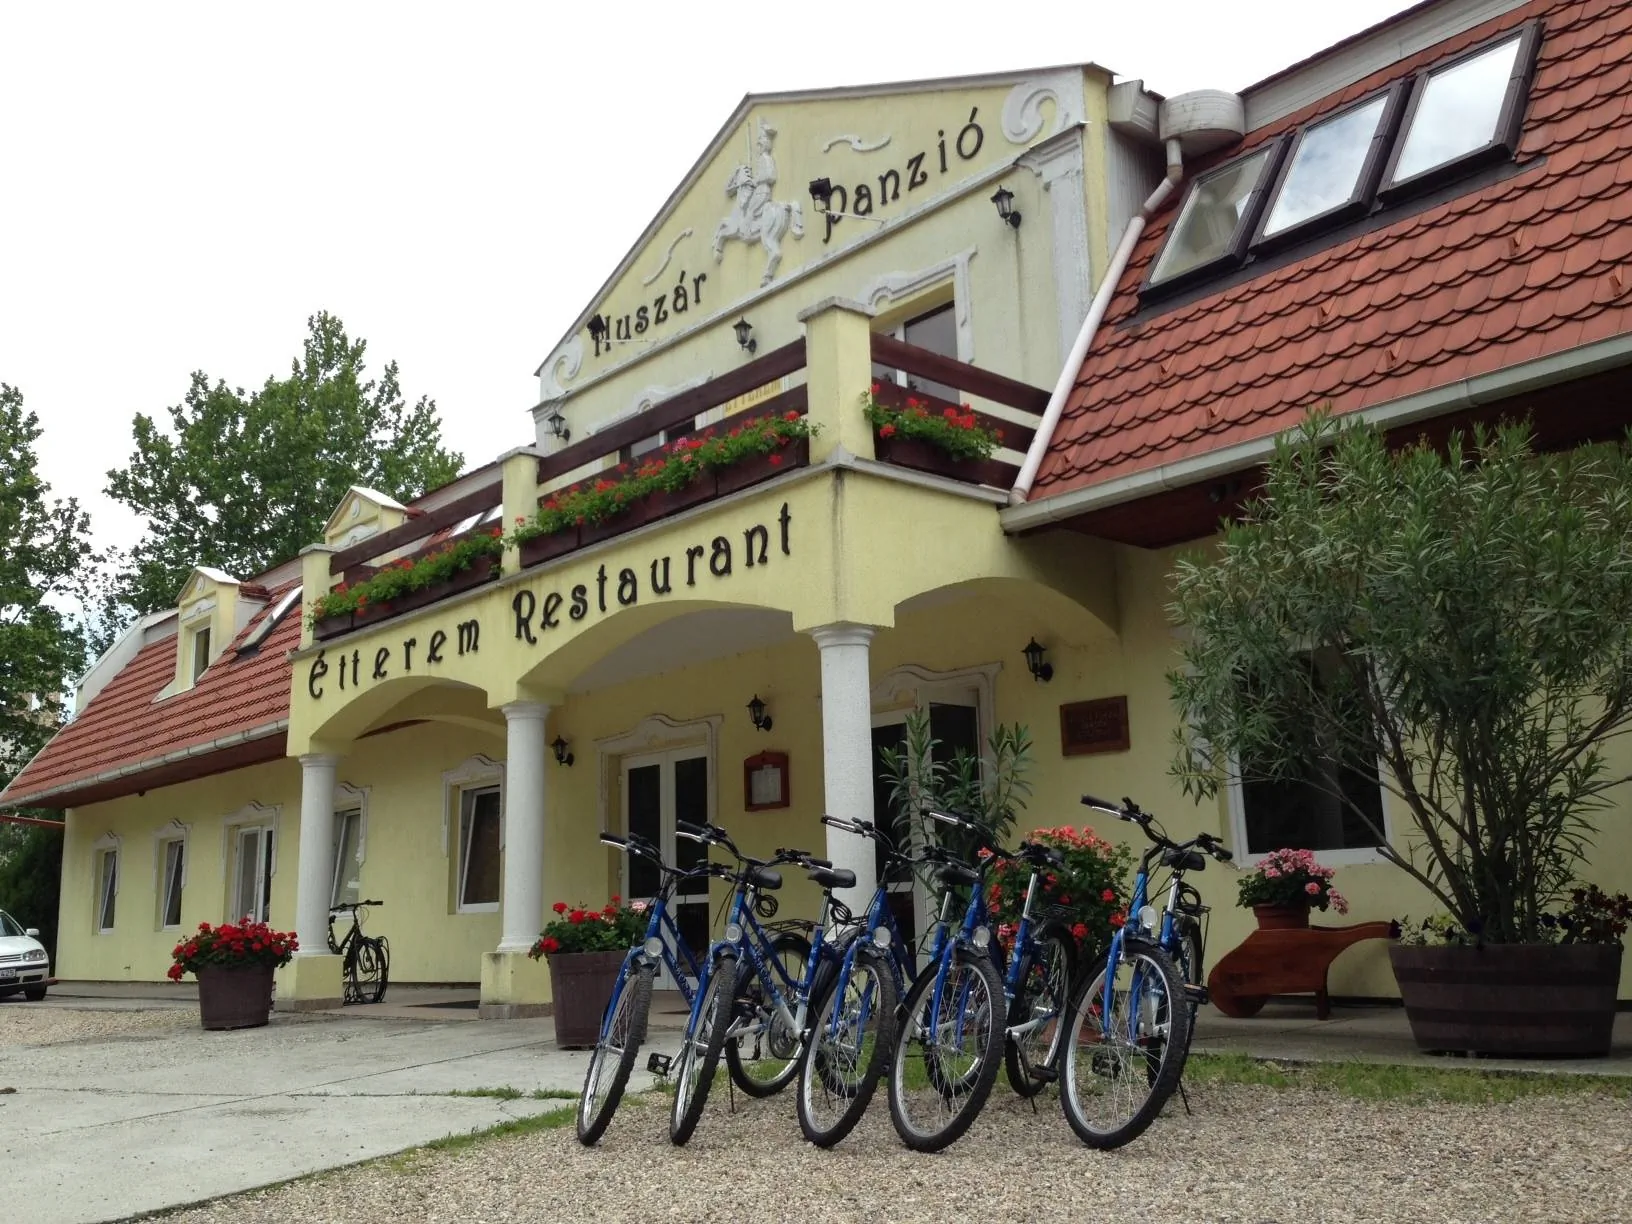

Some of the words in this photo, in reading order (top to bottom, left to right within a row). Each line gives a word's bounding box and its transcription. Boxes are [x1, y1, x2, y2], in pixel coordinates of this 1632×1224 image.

[594, 270, 707, 357] Huszár
[823, 106, 984, 244] panzió
[512, 502, 791, 645] Restaurant
